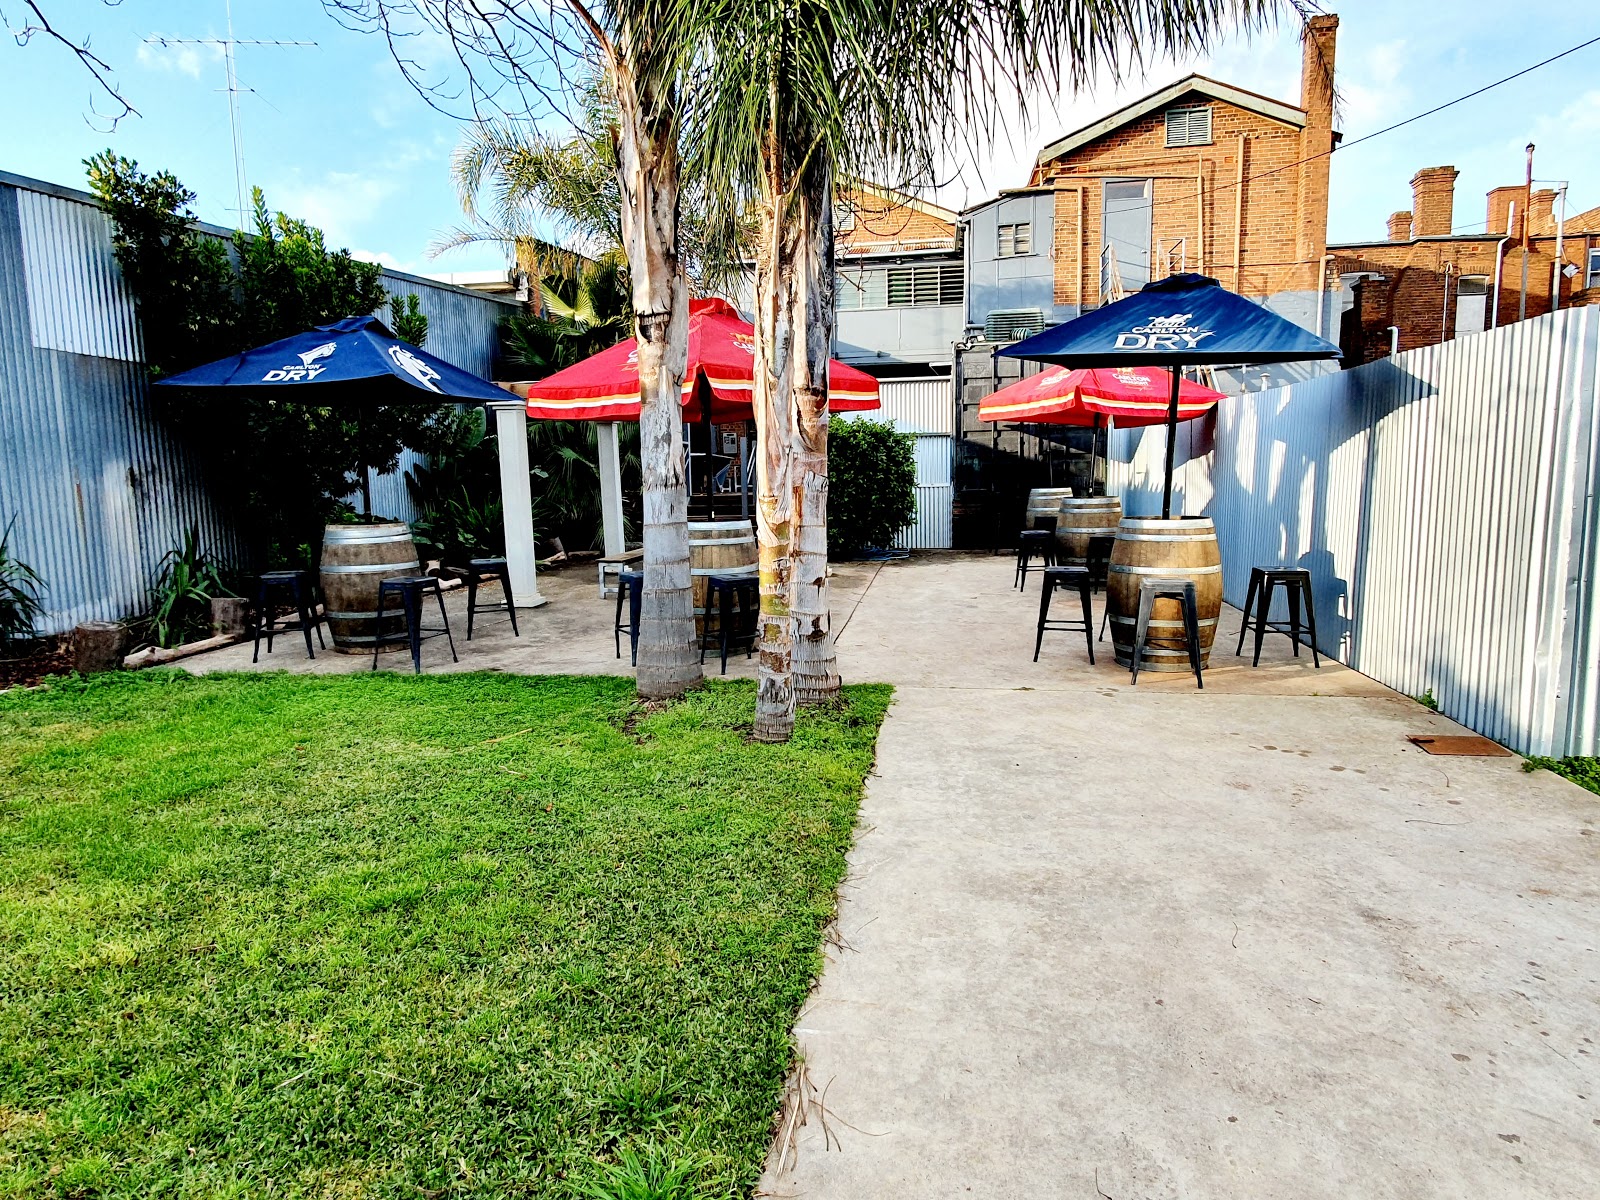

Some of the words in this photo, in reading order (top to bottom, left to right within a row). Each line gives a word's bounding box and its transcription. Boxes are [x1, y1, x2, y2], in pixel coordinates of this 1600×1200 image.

[1131, 326, 1200, 334] CARLTON
[1113, 331, 1216, 349] DRY
[261, 368, 327, 381] DRY
